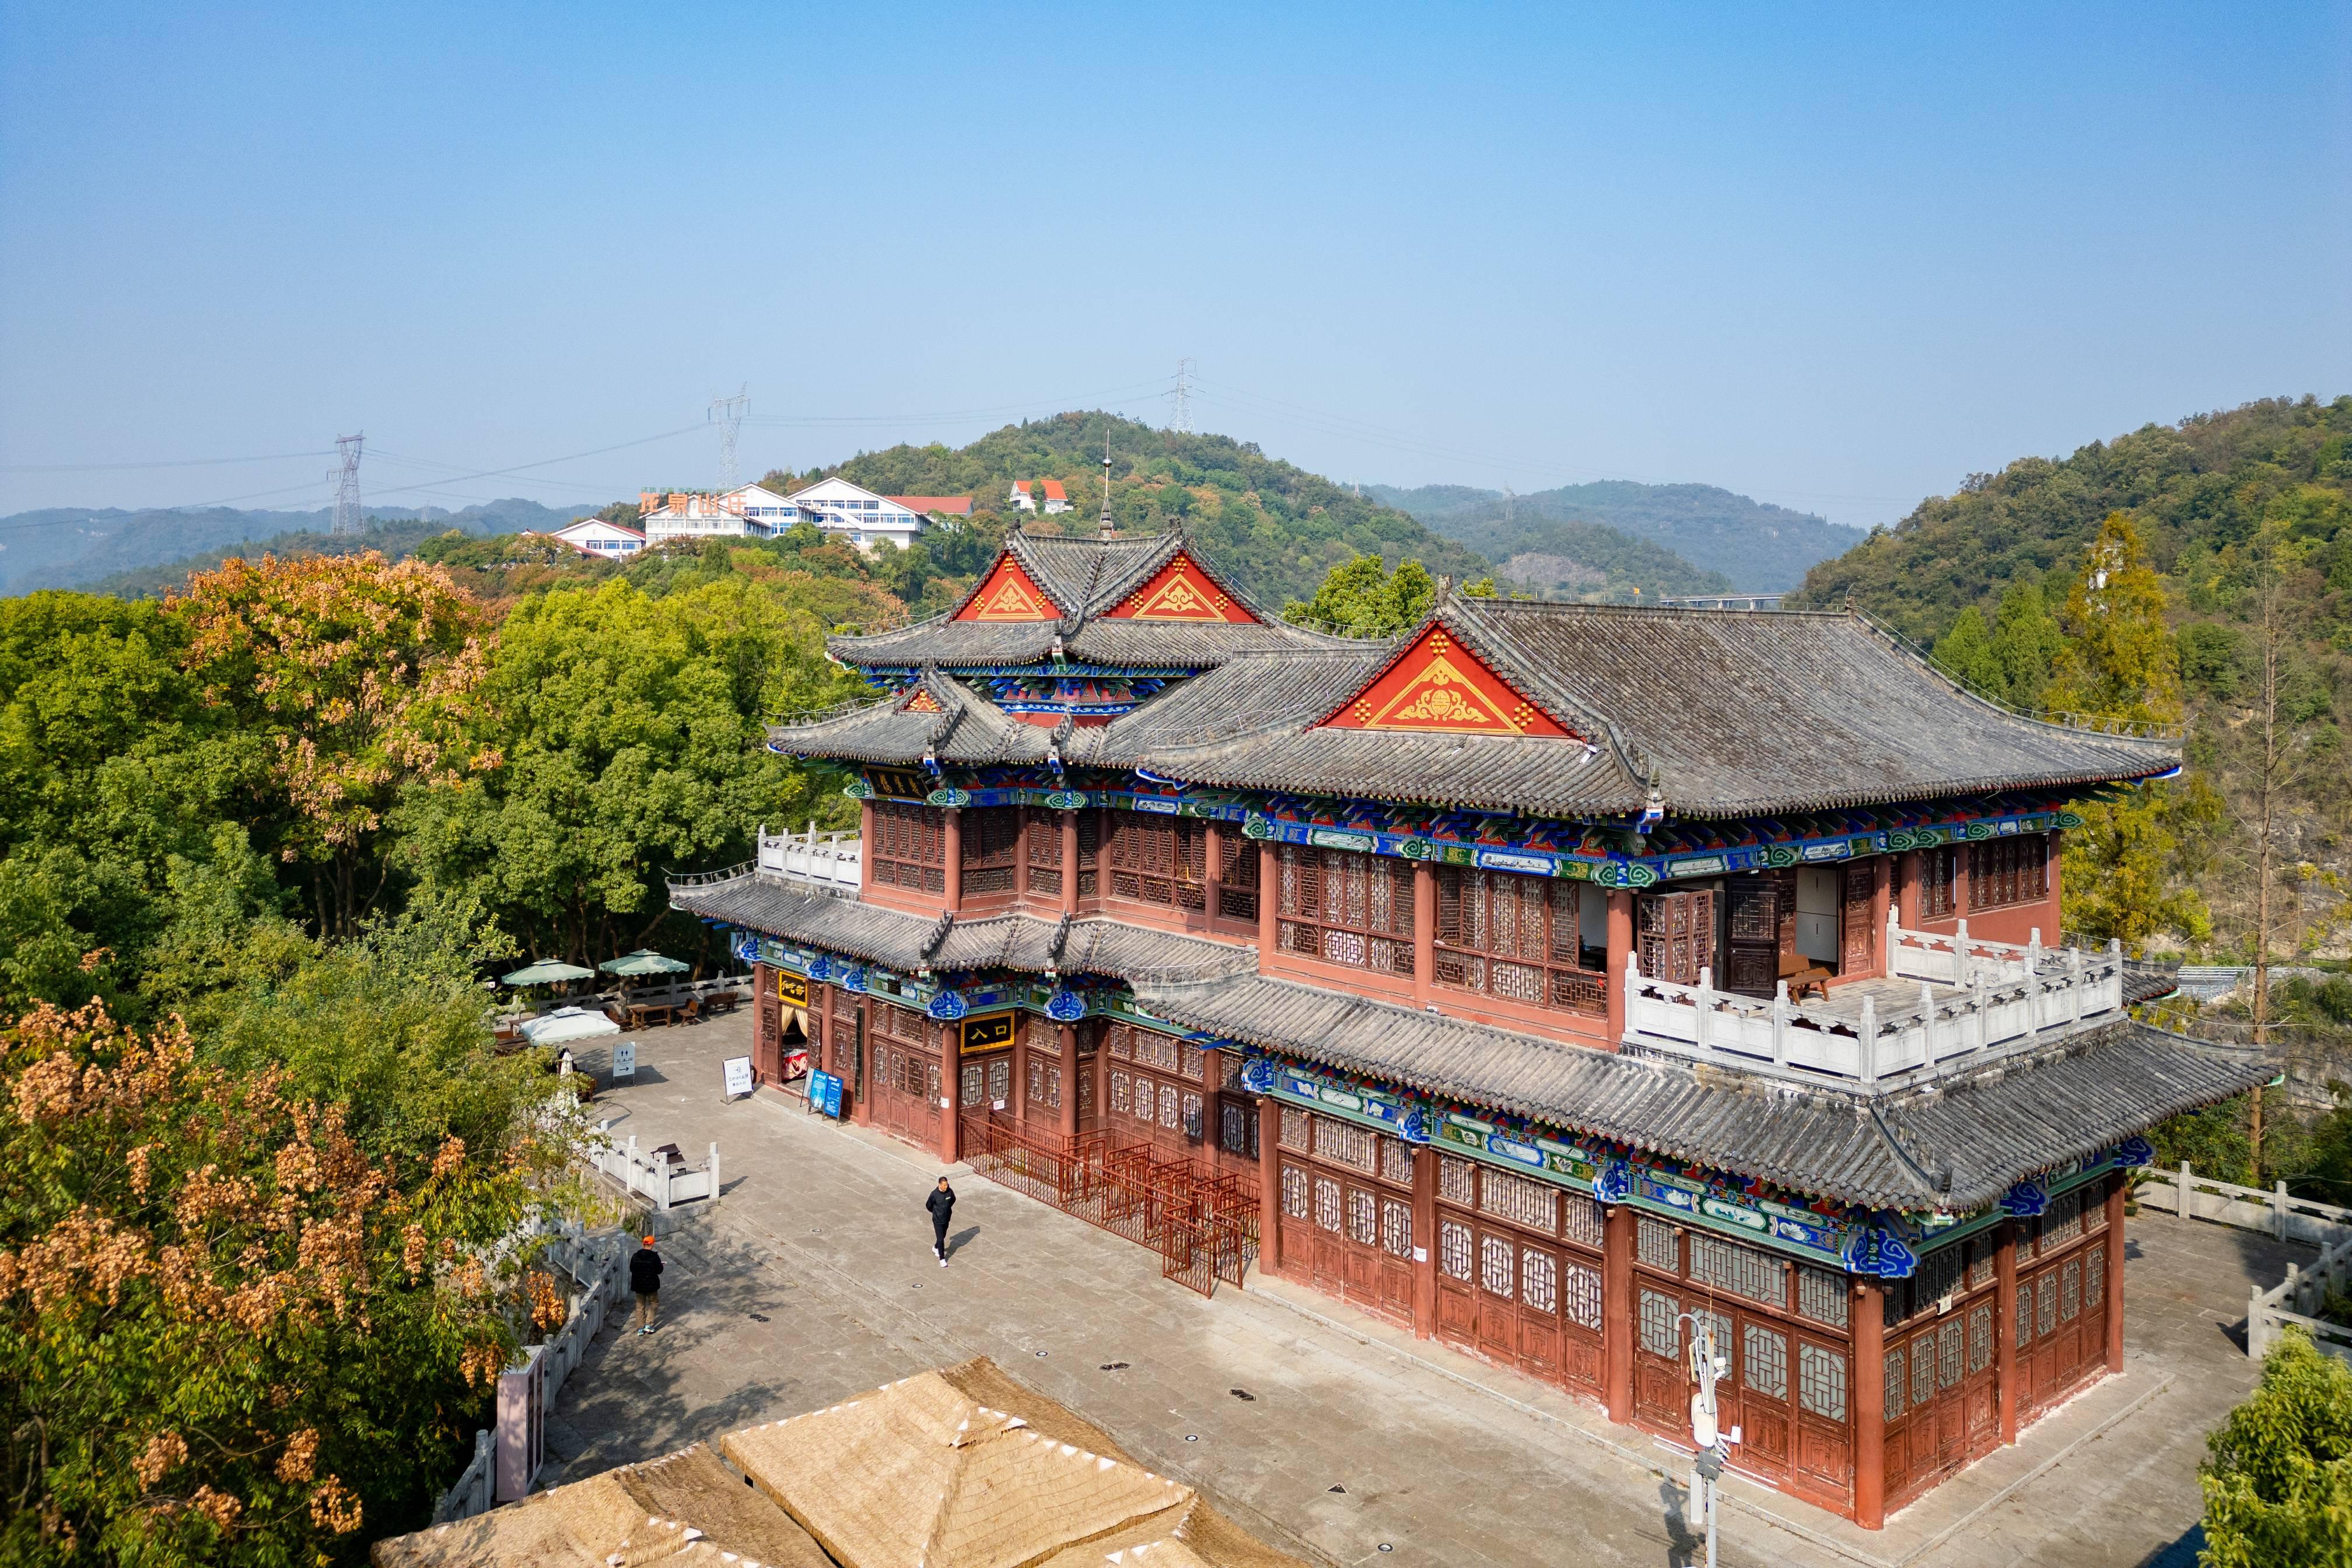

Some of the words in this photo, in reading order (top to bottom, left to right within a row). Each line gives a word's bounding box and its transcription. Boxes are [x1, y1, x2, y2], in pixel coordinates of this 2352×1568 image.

[638, 492, 747, 513] 龙泉山庄
[970, 1025, 1007, 1040] 入口
